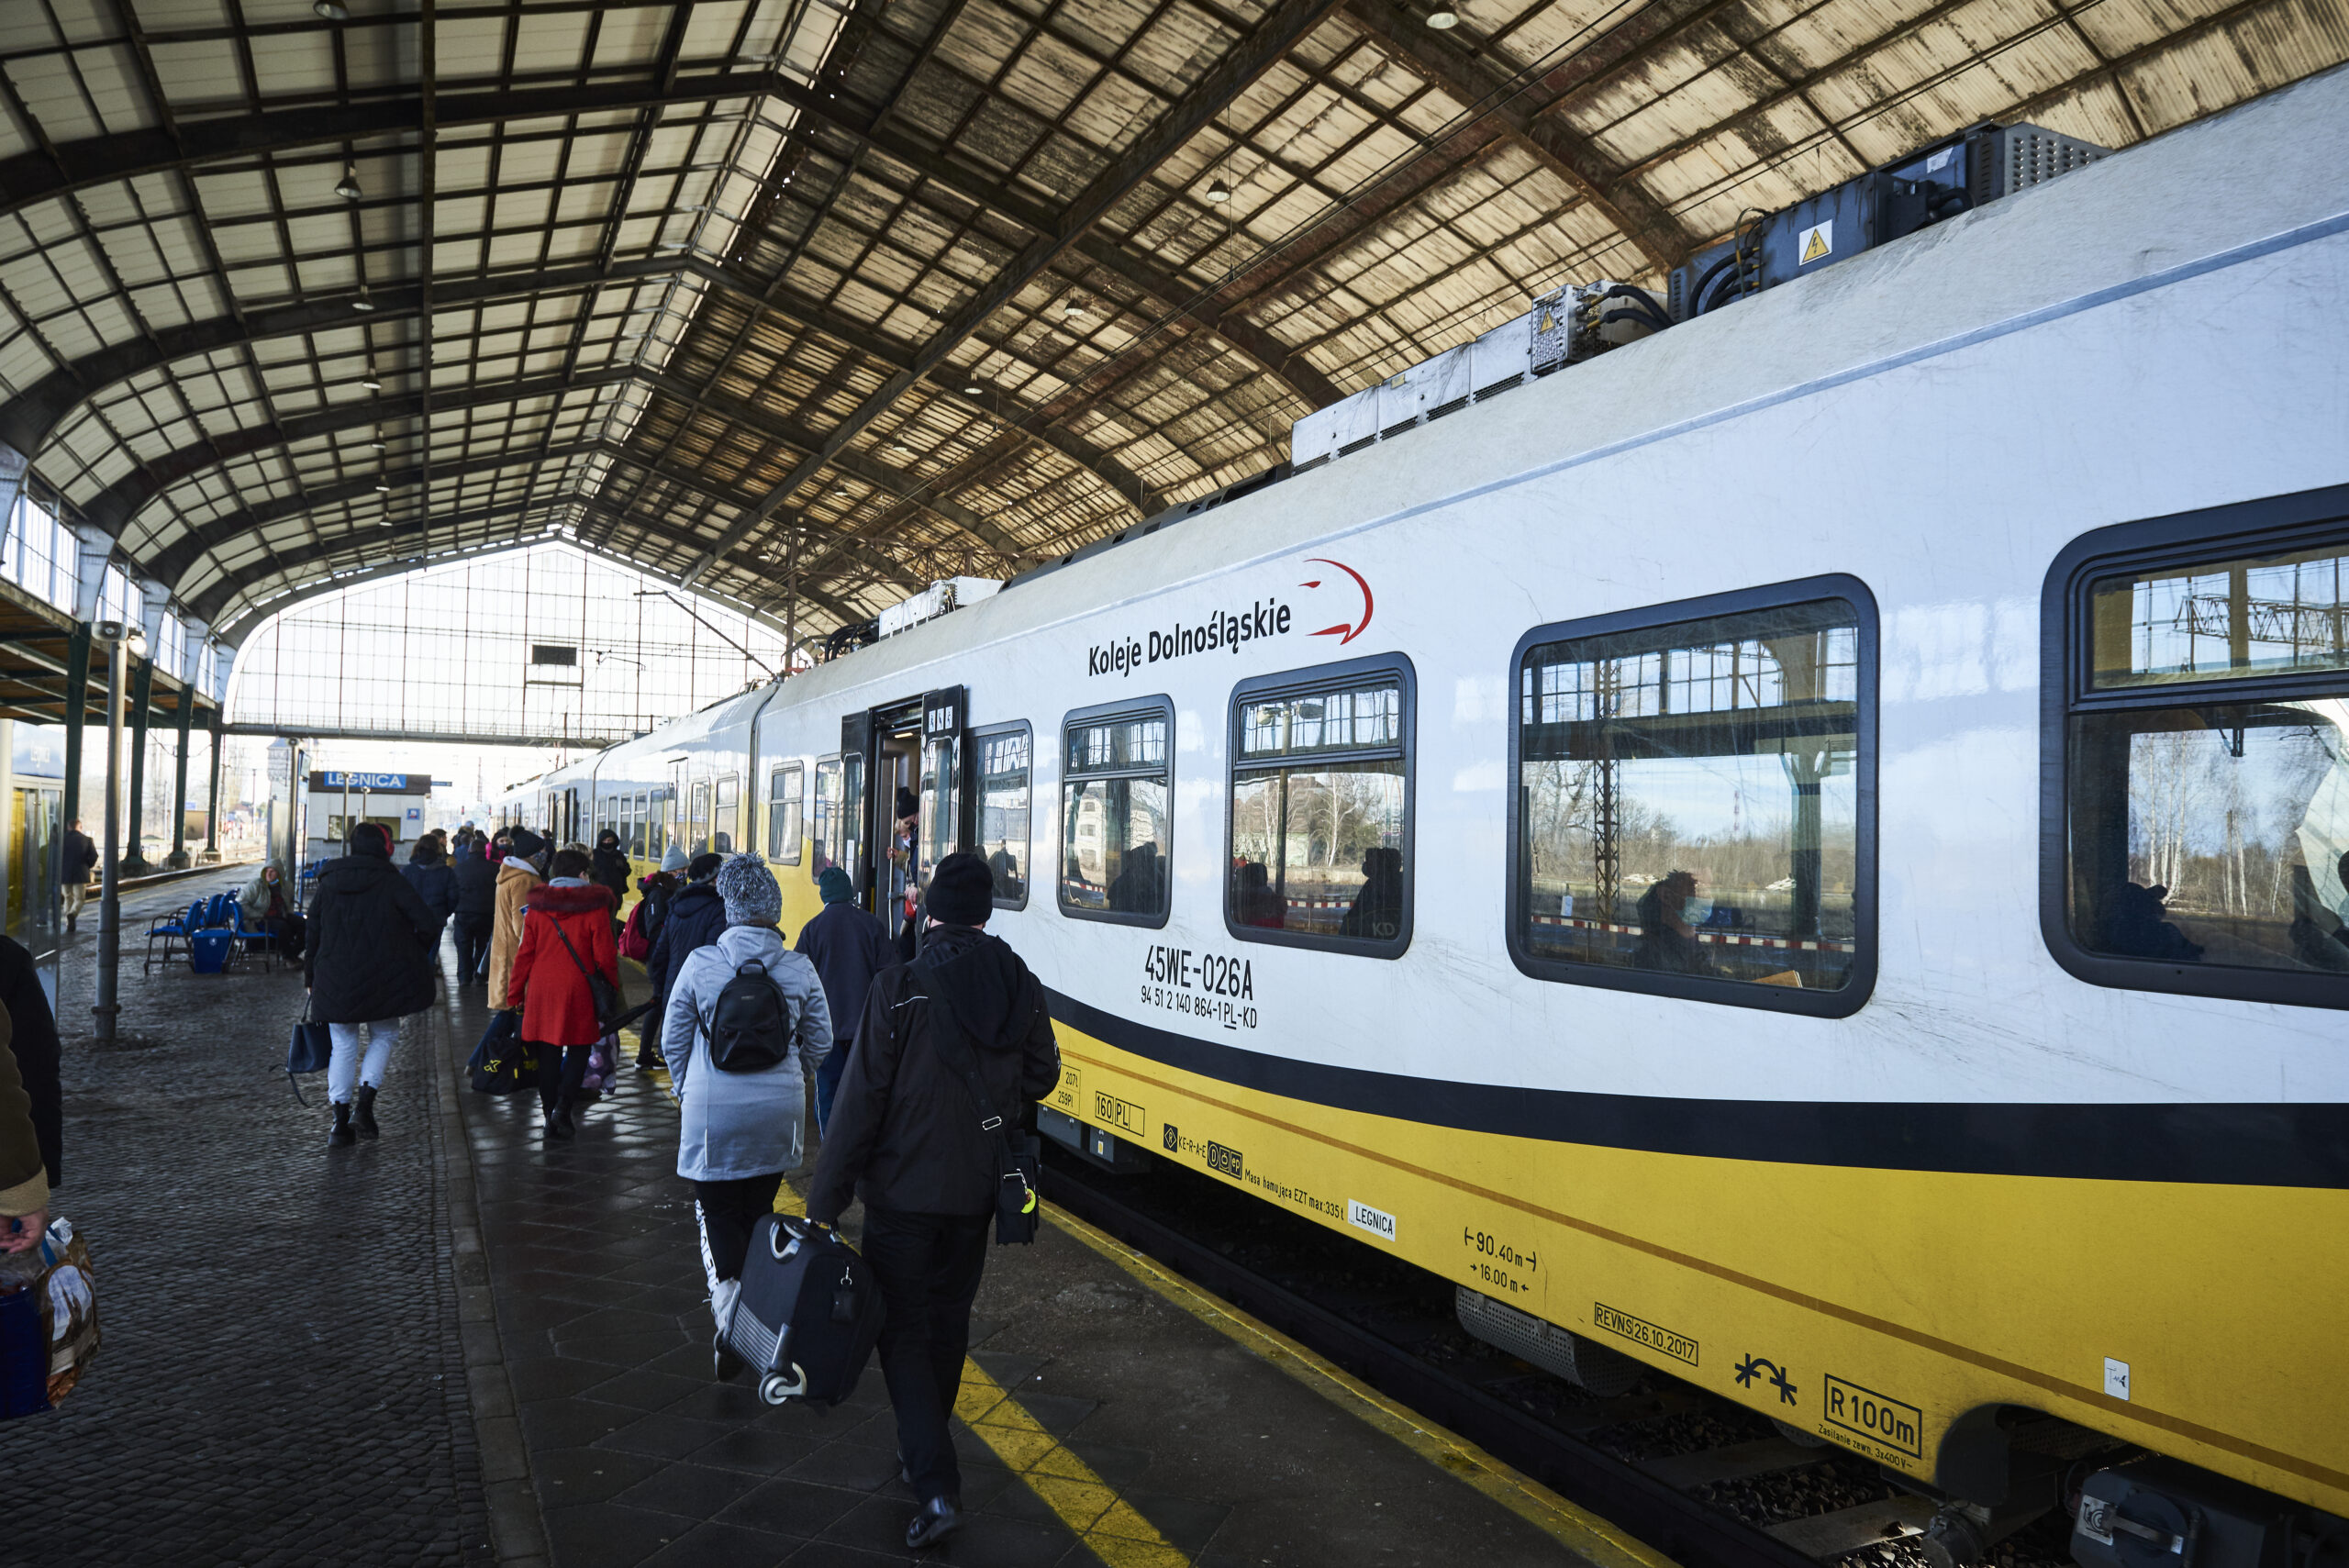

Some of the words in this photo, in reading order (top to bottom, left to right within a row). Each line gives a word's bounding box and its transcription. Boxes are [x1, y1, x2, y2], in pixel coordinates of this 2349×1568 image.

[1088, 636, 1141, 677] Koleje
[1148, 597, 1291, 663] Dolnośląskie
[328, 772, 402, 788] LEGNICA
[1372, 921, 1395, 936] KD
[1144, 944, 1253, 1001] 45WE-026A
[1141, 984, 1152, 1005] 94
[1154, 987, 1163, 1007] 51
[1166, 990, 1173, 1009] 2
[1175, 992, 1191, 1014] 140
[1097, 1095, 1112, 1119] 160
[1116, 1102, 1129, 1127] PL
[1244, 1168, 1261, 1186] Masa
[1263, 1176, 1292, 1199] hamująca
[1294, 1188, 1308, 1206] EZT
[1355, 1206, 1394, 1236] LEGNICA
[1634, 1322, 1695, 1360] 26.10.2017
[1818, 1423, 1851, 1446] Zasilanie
